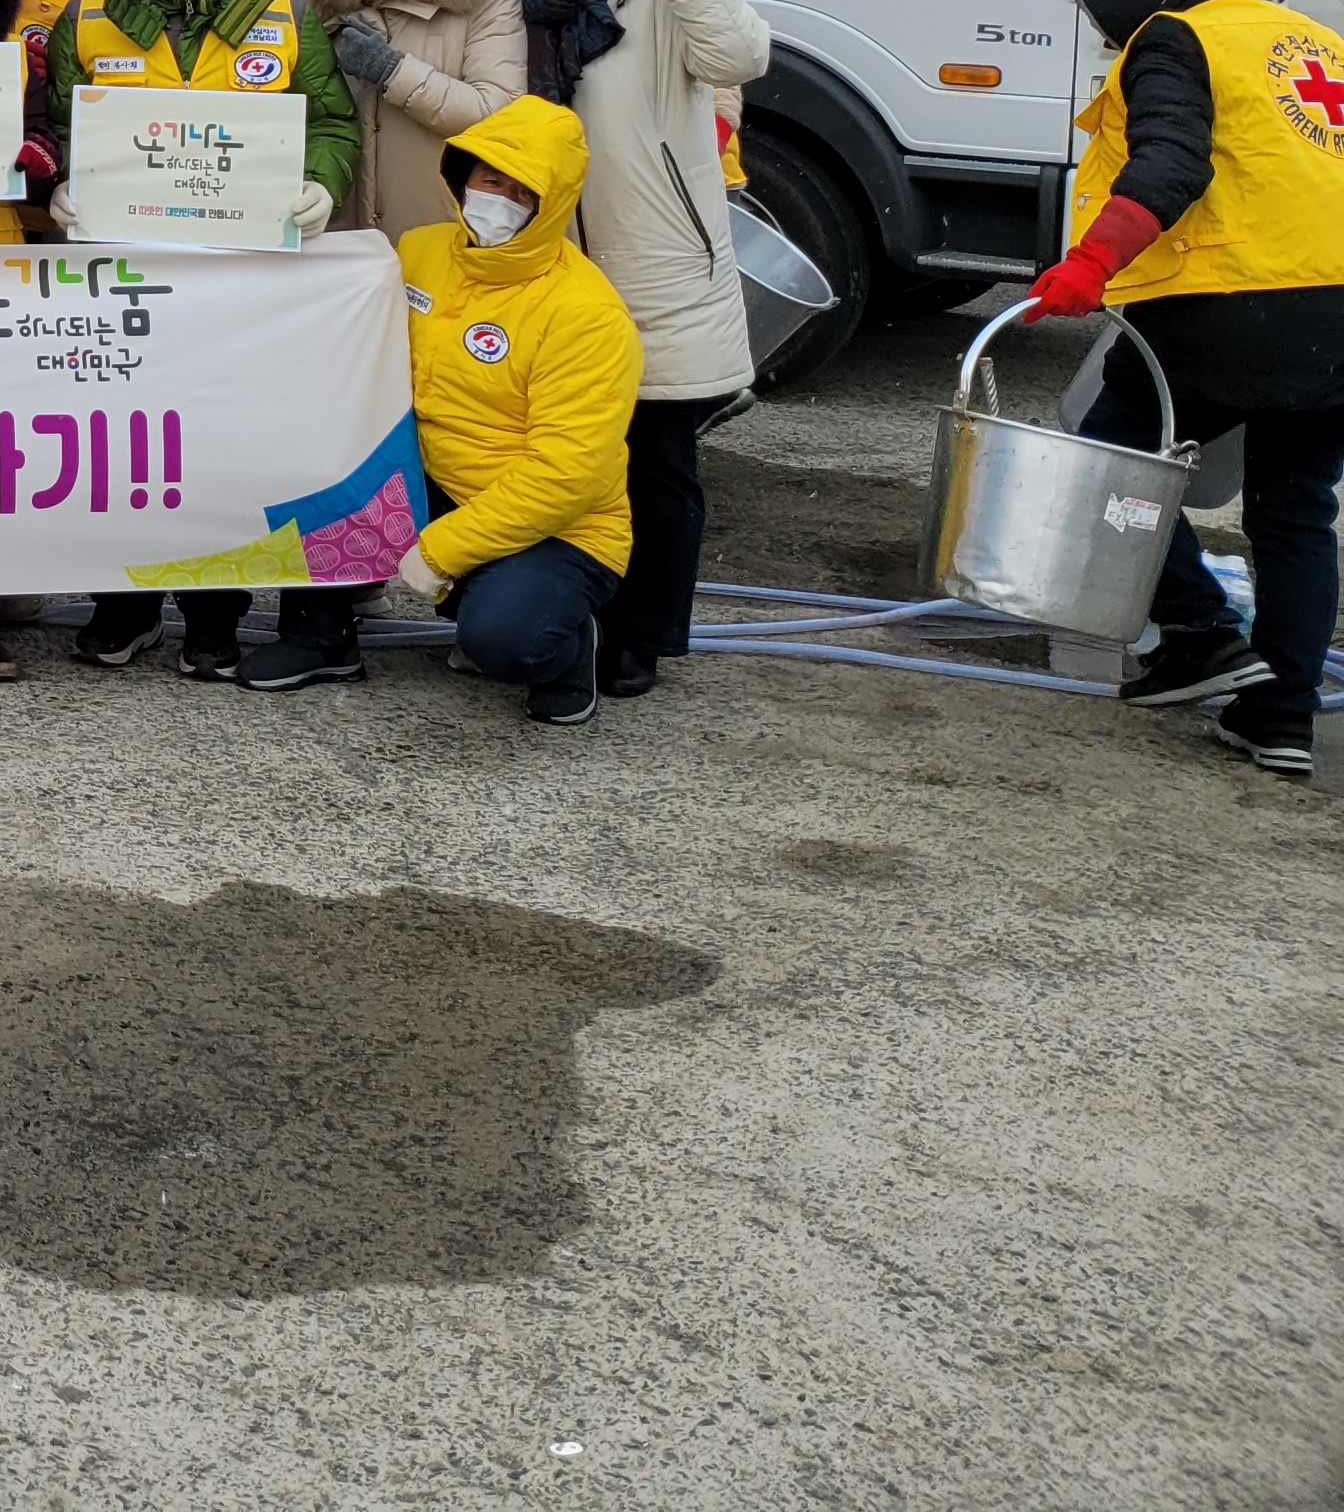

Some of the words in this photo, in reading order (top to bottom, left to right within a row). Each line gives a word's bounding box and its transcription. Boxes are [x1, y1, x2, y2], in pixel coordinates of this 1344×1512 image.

[1267, 35, 1344, 78] 대한적십자
[1276, 94, 1328, 149] KOREAN
[132, 121, 245, 173] 온기나눔
[165, 154, 215, 177] 하나되는
[174, 175, 227, 198] 대한민국
[16, 313, 117, 346] 하나되는
[37, 346, 143, 383] 대한민국
